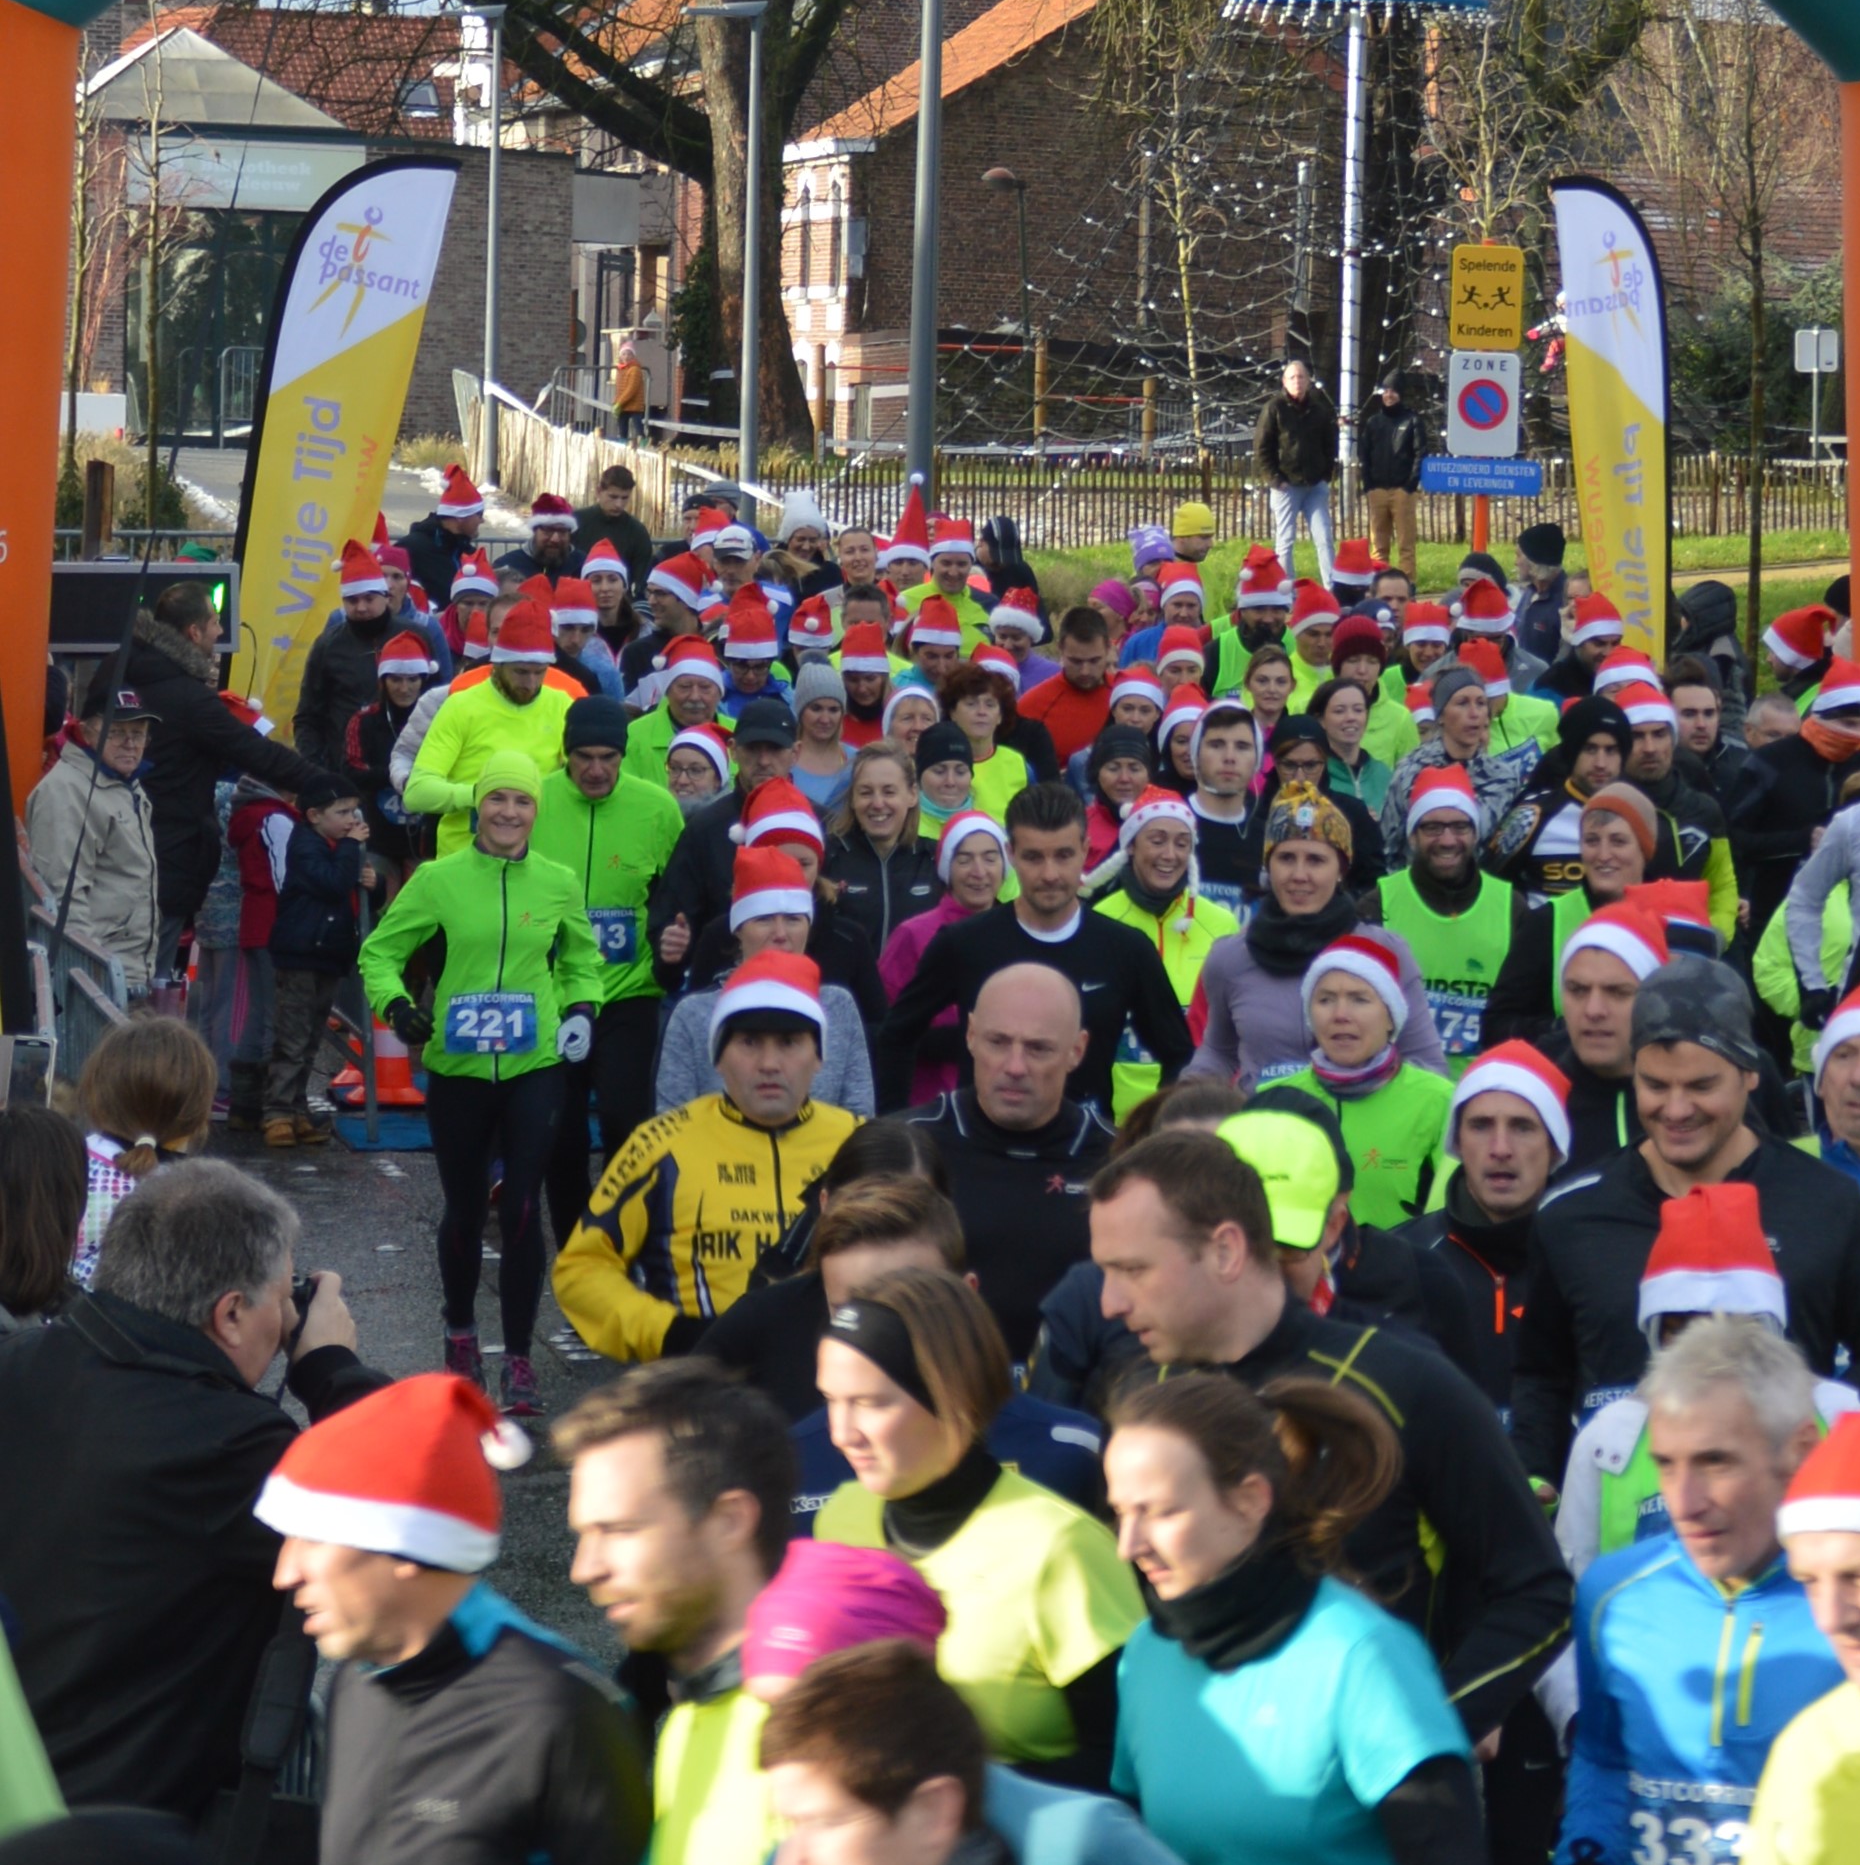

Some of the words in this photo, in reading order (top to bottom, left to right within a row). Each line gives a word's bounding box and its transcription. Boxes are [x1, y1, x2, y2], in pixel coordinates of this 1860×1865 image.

[319, 235, 349, 262] de
[1459, 258, 1517, 273] Spelende
[319, 261, 421, 300] passant
[1457, 323, 1514, 338] Kinderen
[1462, 359, 1509, 372] ZONE
[292, 395, 346, 481] Tijd
[1427, 461, 1491, 474] UITGEZONDERD
[1494, 464, 1536, 477] DIENSTEN
[1447, 477, 1459, 487] EN
[1463, 478, 1515, 489] LEVERINGEN
[275, 501, 334, 616] Vrije
[455, 1009, 523, 1038] 221
